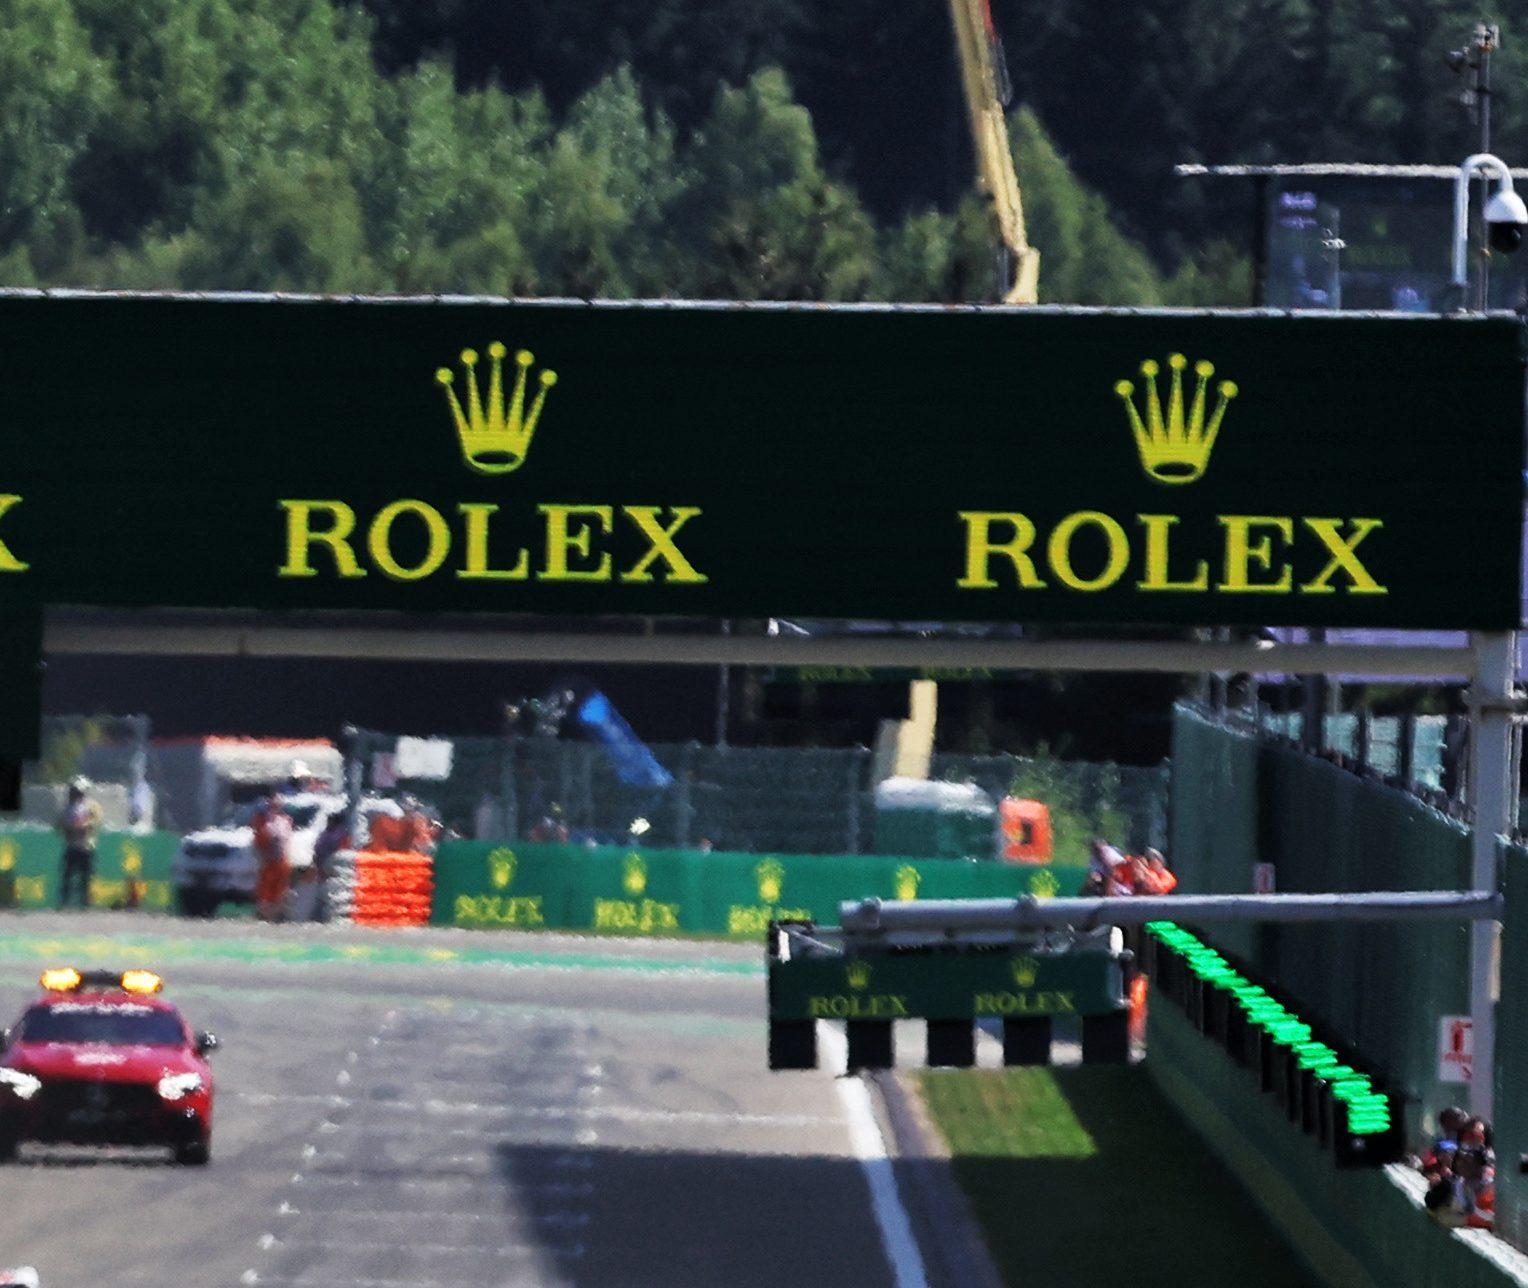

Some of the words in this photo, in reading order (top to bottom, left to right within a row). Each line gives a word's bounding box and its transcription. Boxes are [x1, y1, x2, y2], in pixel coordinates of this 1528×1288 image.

[277, 497, 708, 583] ROLEX
[955, 508, 1388, 595] ROLEX
[974, 992, 1075, 1014] ROLEX
